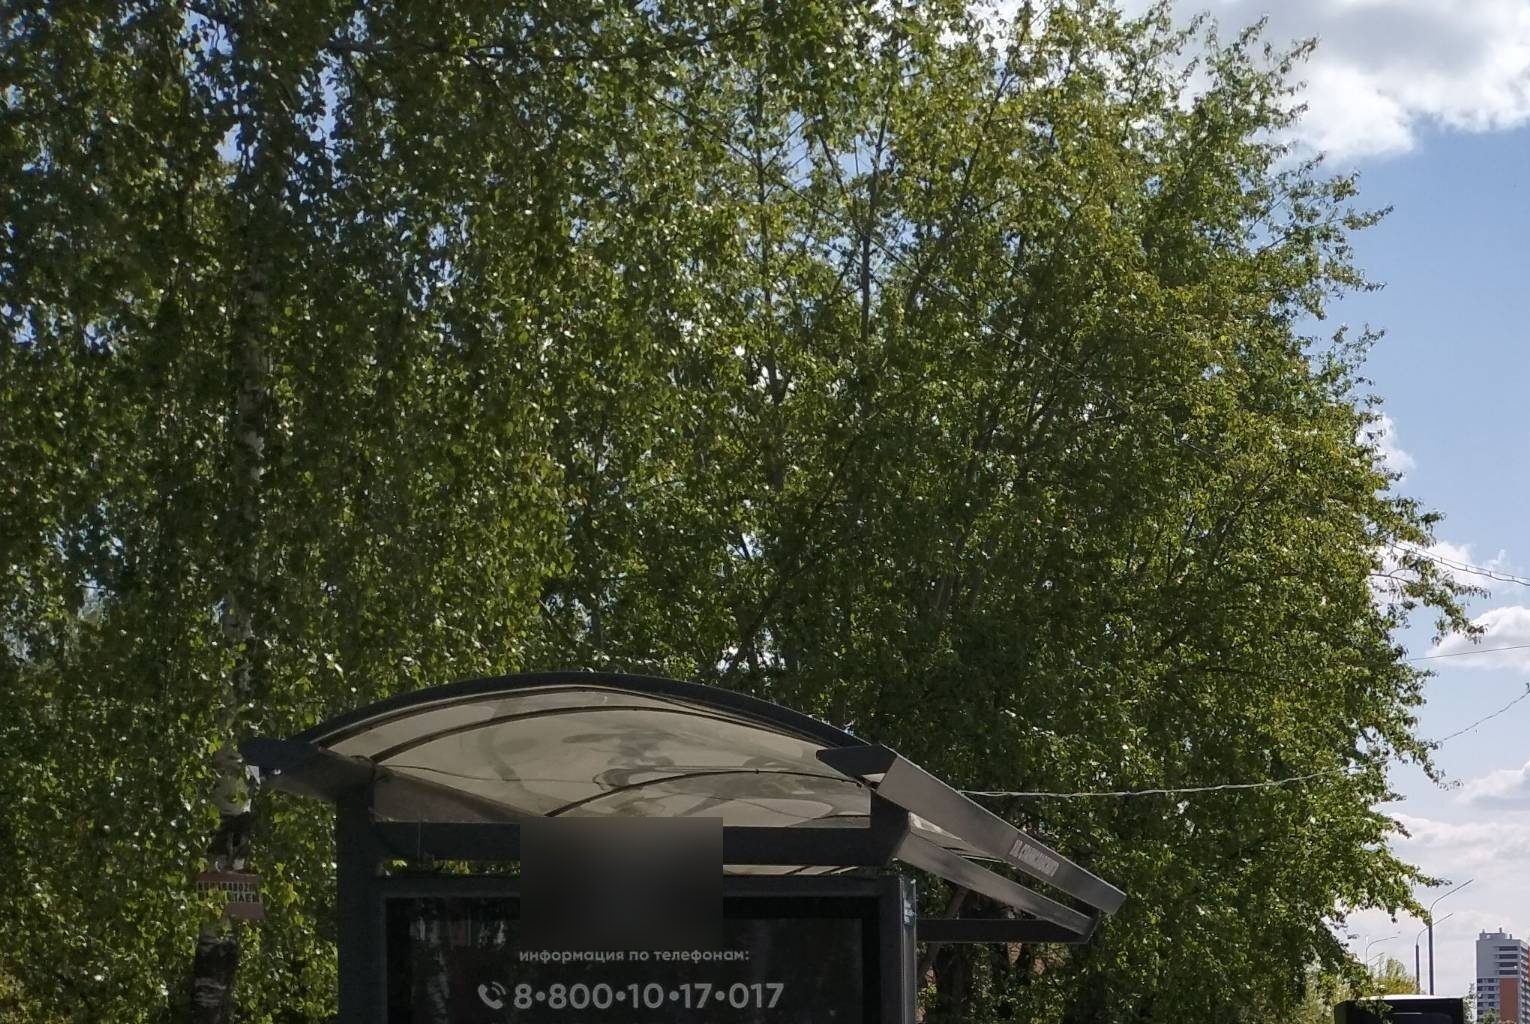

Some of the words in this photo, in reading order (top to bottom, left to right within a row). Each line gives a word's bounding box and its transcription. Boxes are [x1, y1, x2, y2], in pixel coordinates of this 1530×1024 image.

[519, 950, 625, 963] информация
[628, 950, 650, 961] по
[653, 949, 750, 963] телефонам:
